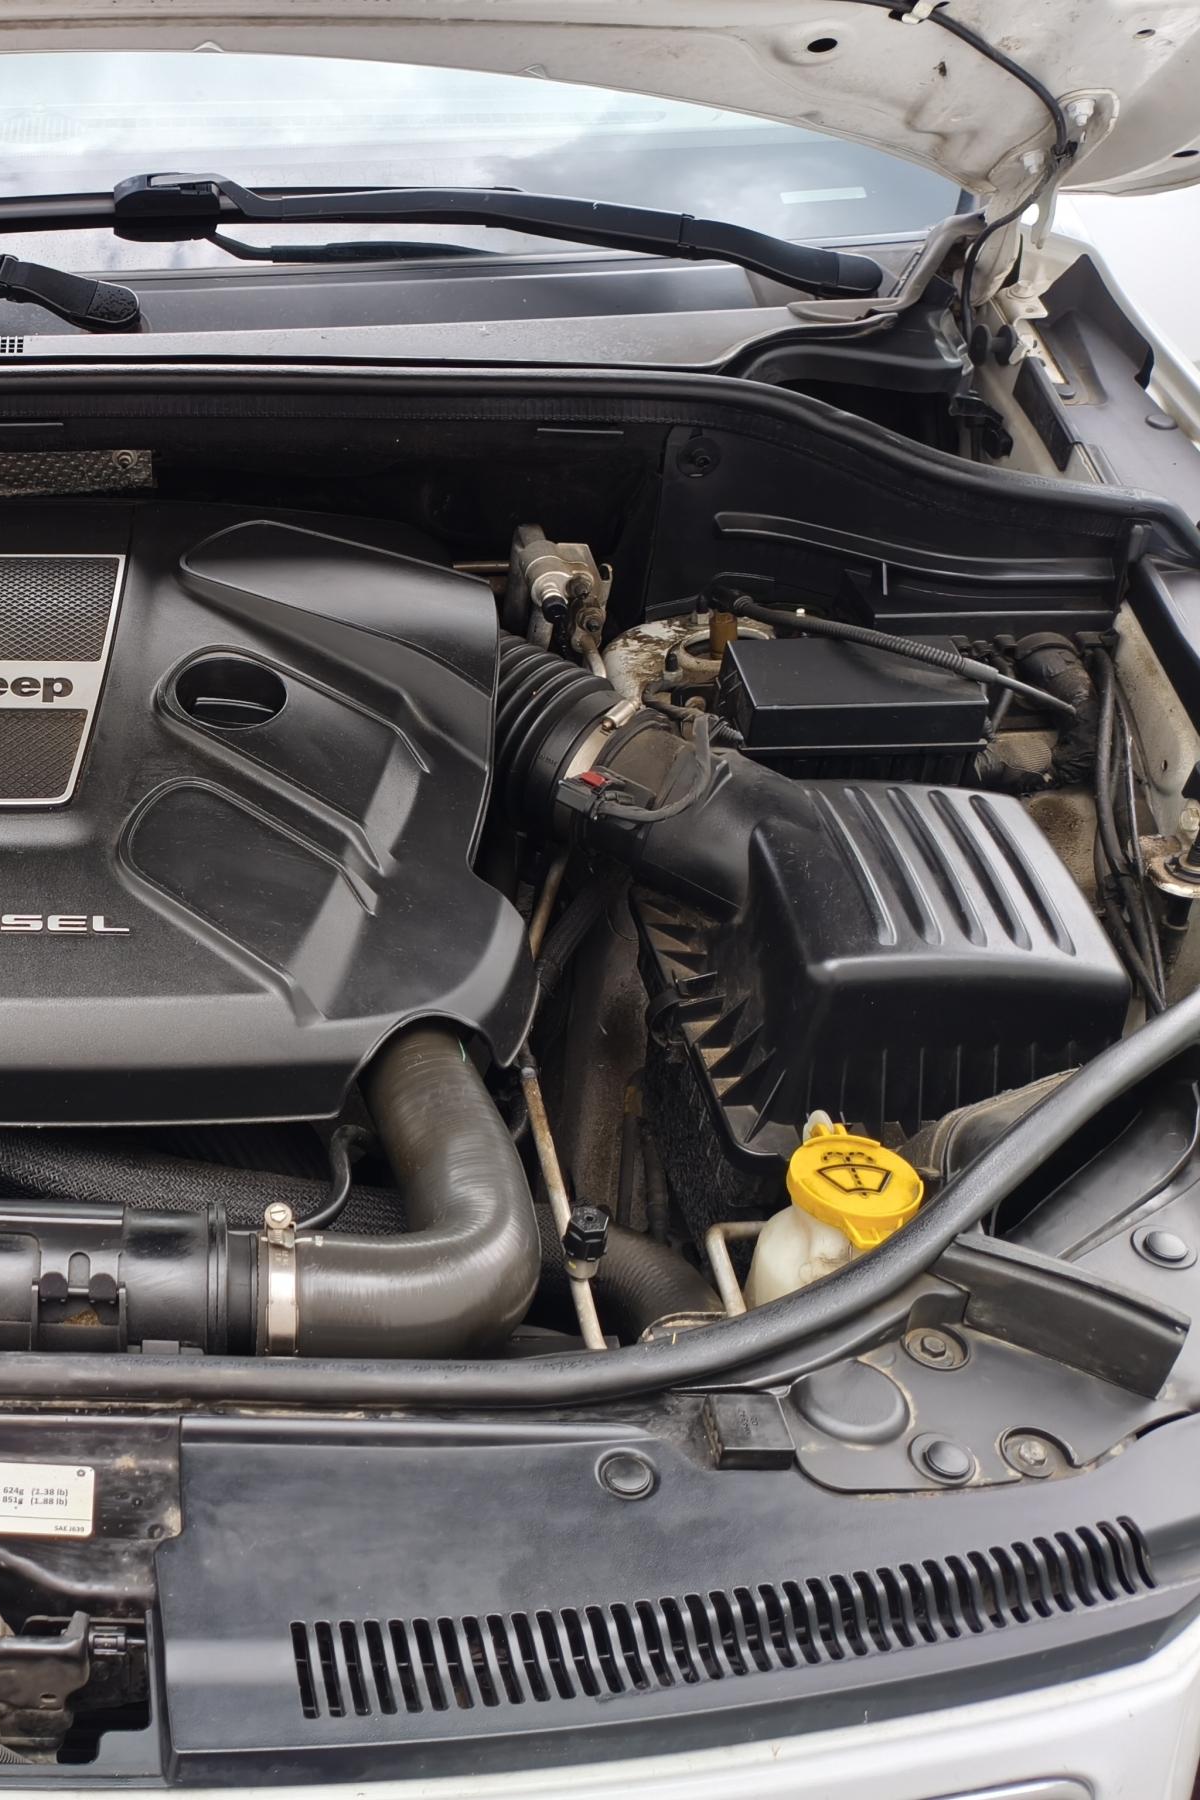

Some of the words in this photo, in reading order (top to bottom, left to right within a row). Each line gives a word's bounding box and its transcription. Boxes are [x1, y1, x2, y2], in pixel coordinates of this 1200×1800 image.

[3, 1486, 24, 1496] 624g
[57, 1488, 68, 1497] lb)
[55, 1497, 68, 1506] lb)
